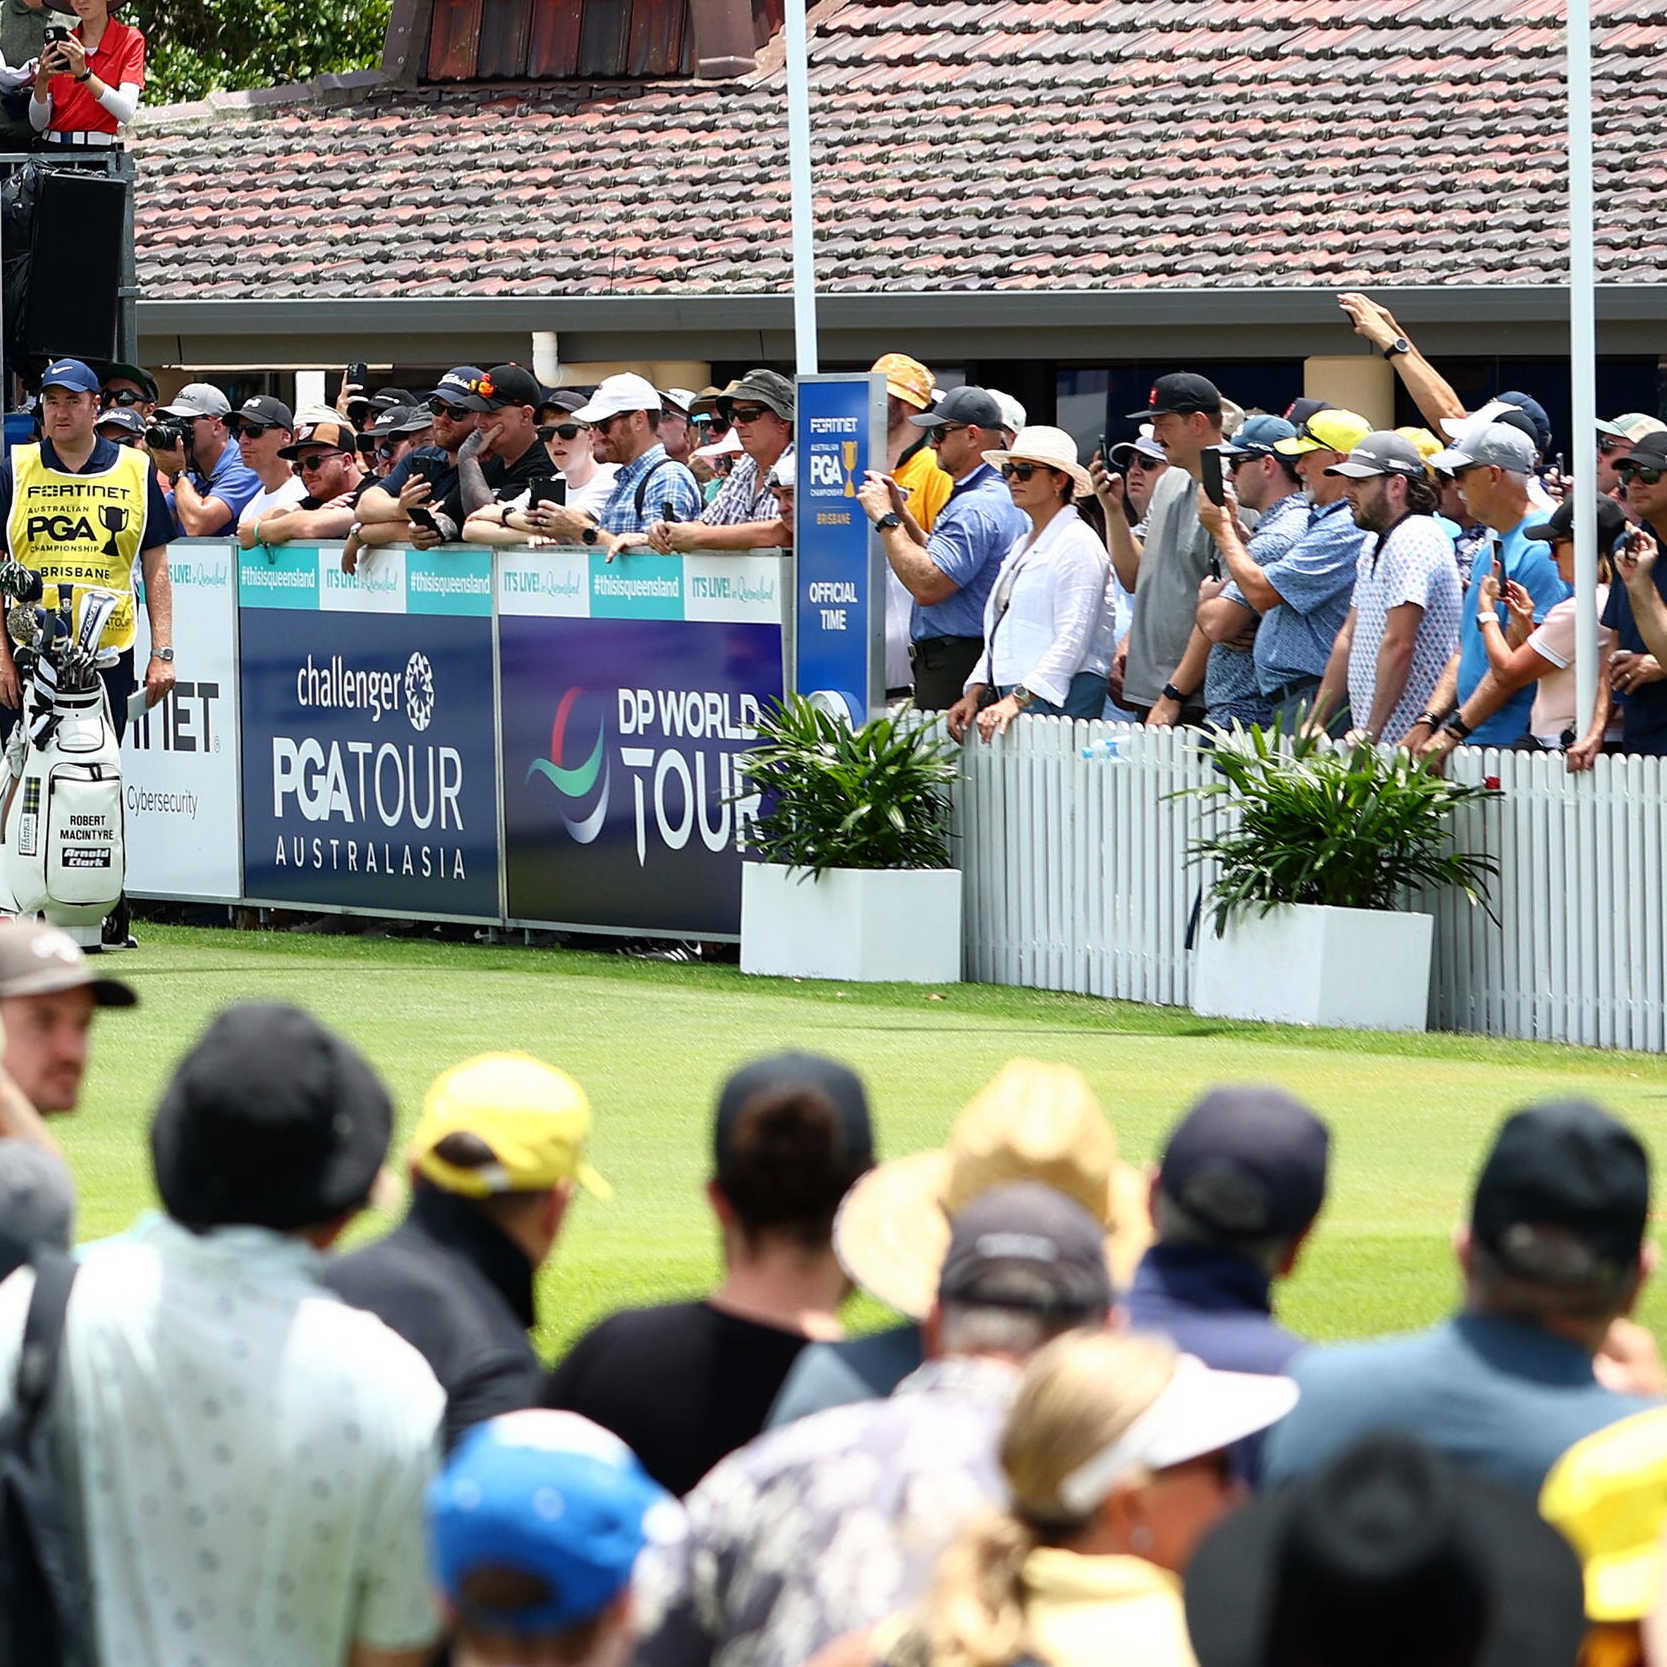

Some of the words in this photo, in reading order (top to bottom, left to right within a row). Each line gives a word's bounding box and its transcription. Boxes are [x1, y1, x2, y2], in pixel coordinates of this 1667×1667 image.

[810, 455, 844, 485] PGA
[28, 484, 130, 500] FORTINET
[28, 505, 90, 514] AUSTRALIAN
[816, 512, 852, 526] BRISBANE
[27, 515, 97, 542] PGA
[29, 545, 100, 554] CHAMPIONSHIP
[40, 566, 111, 580] BRISBANE
[241, 567, 316, 590] #thisisqueensland
[519, 572, 540, 595] LIVE!
[410, 574, 491, 597] #thisisqueensland
[594, 574, 679, 601] #thisisqueensland
[708, 577, 731, 600] LIVE!
[809, 582, 858, 604] OFFICIAL
[820, 609, 847, 631] TIME
[297, 653, 402, 722] challenger
[618, 688, 655, 735] DP
[657, 690, 761, 740] WORLD
[127, 786, 199, 821] Cybersecurity
[70, 815, 107, 827] ROBERT
[60, 829, 115, 841] MACINTYRE
[64, 848, 109, 858] Arnold
[68, 857, 105, 867] Clark
[275, 835, 466, 880] AUSTRALASIA
